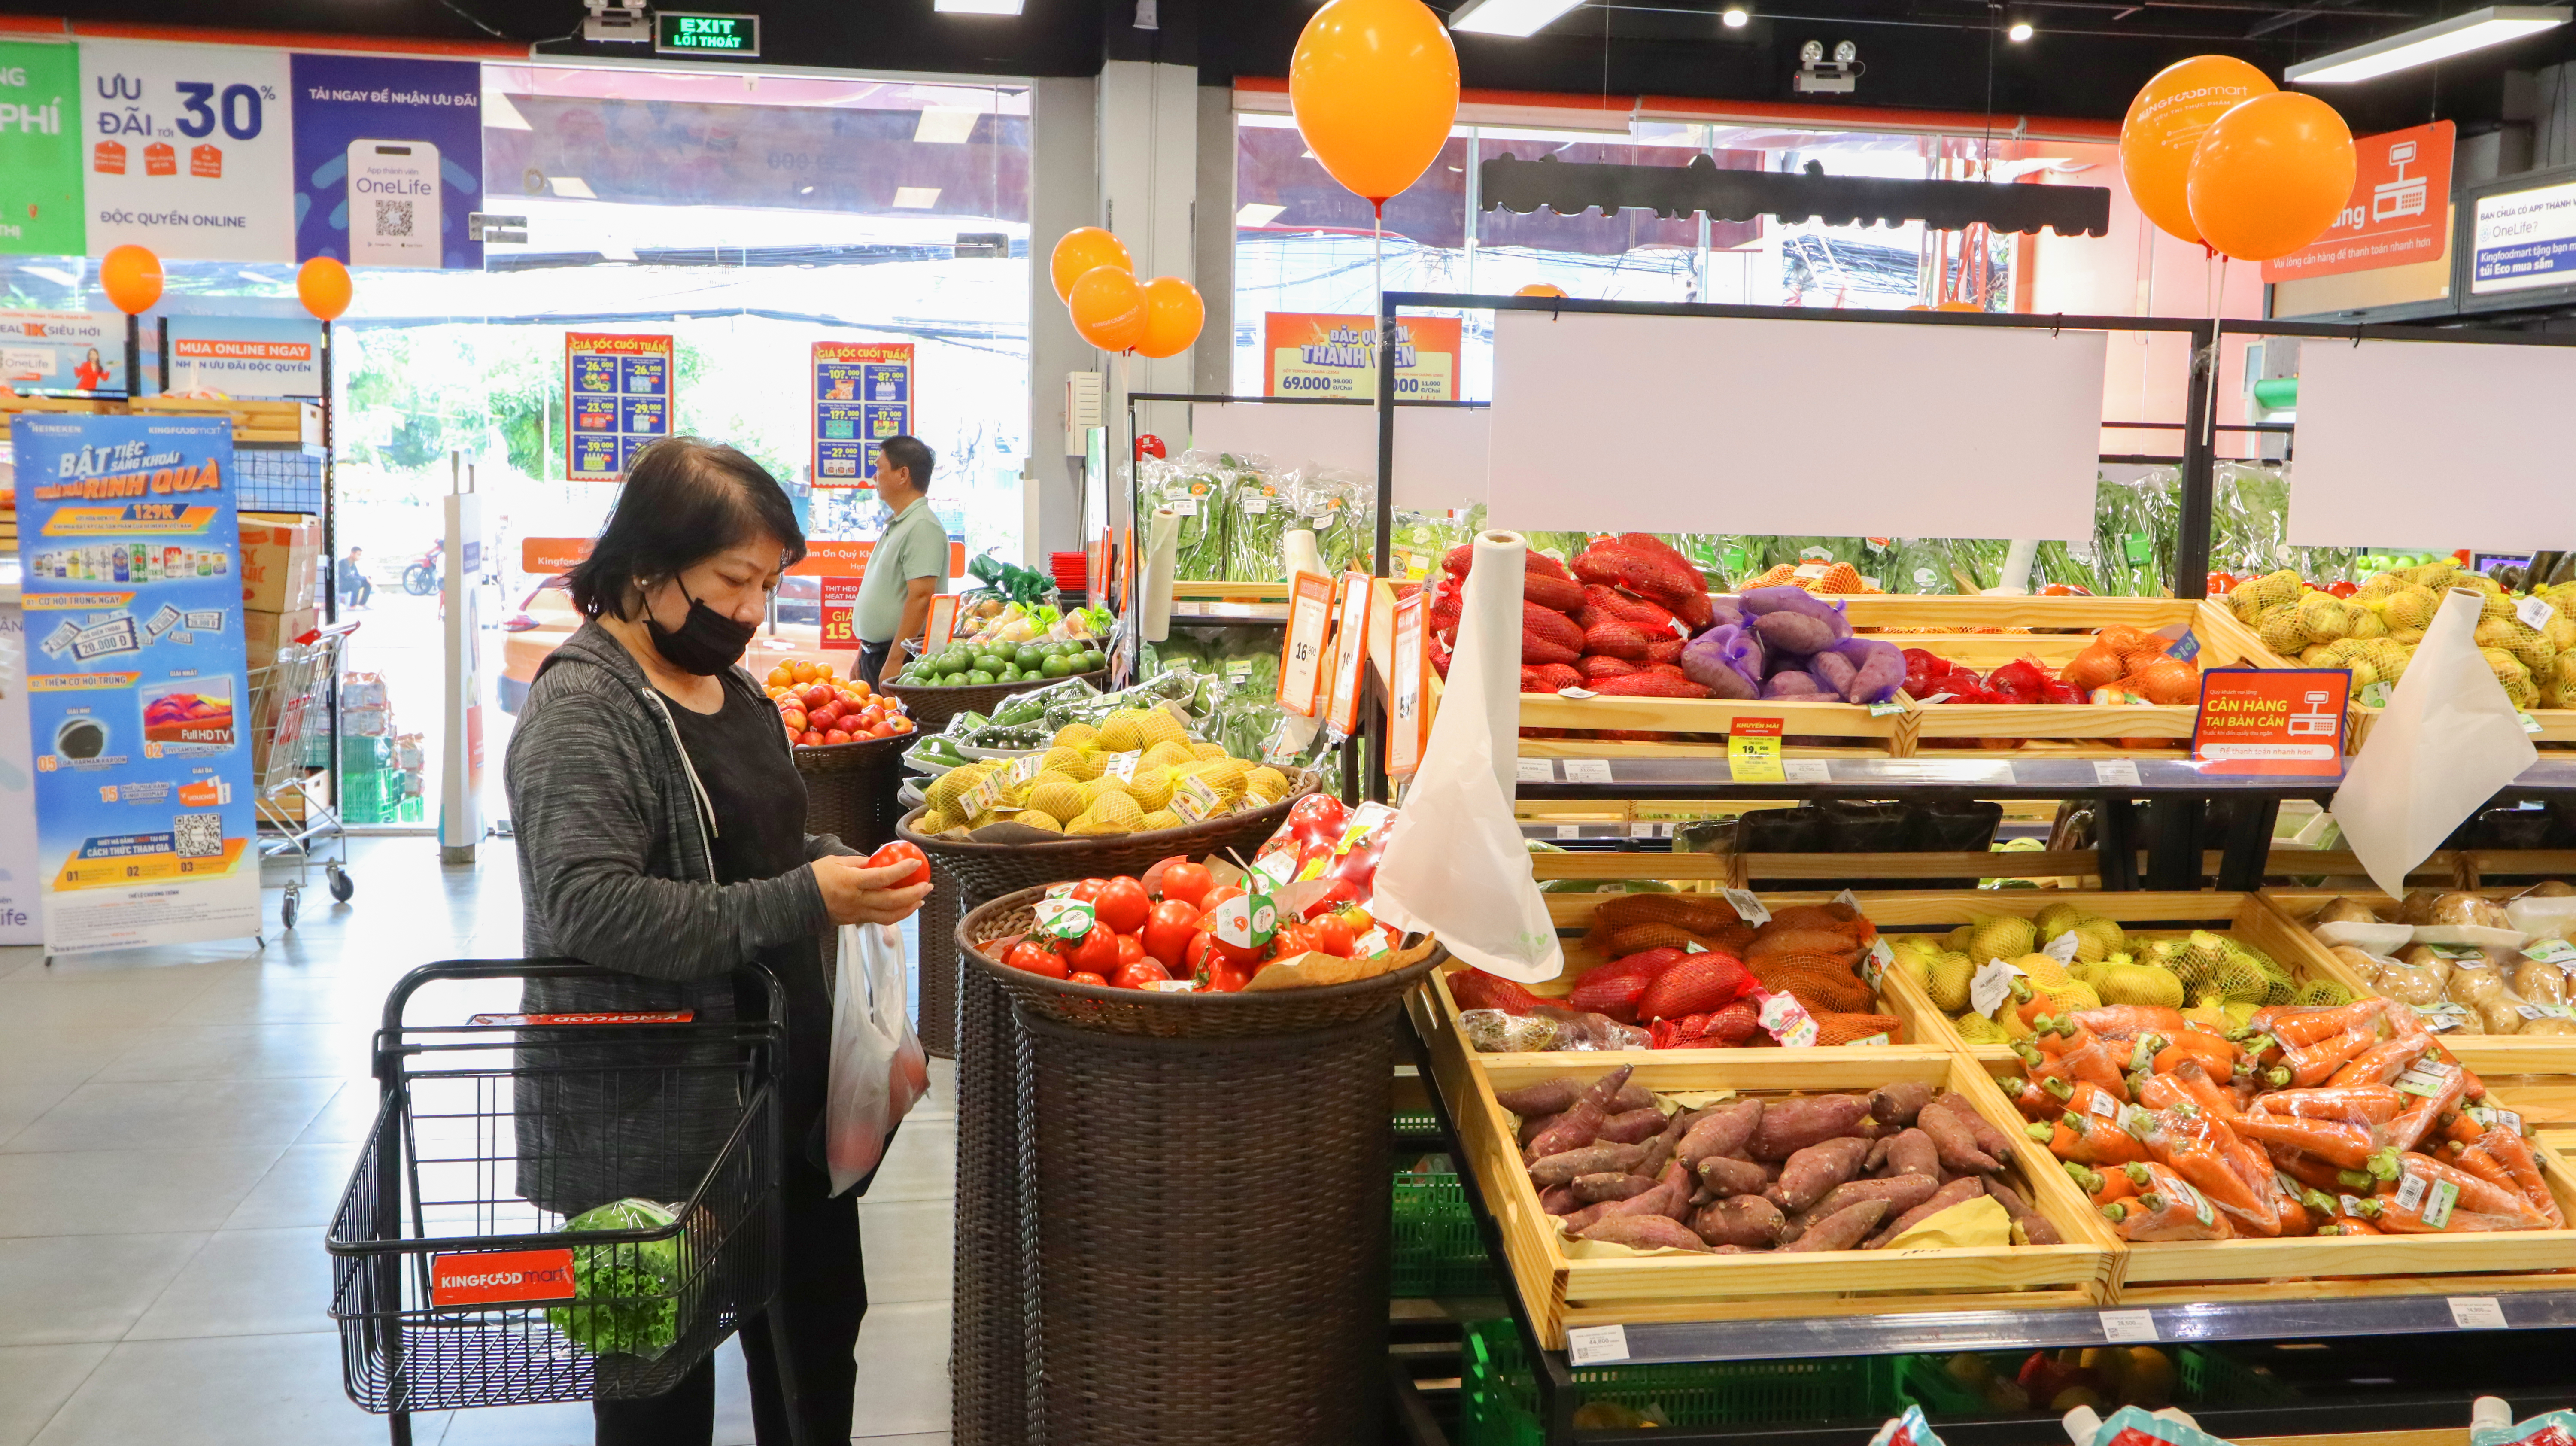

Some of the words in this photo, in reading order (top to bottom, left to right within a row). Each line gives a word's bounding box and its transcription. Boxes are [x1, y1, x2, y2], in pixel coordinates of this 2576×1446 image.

[680, 18, 735, 34] EXIT
[699, 35, 741, 48] THOÁT
[97, 73, 141, 100] ƯU
[309, 86, 329, 100] TẢI
[332, 90, 368, 102] NGAY
[371, 88, 388, 103] ĐỂ
[392, 91, 429, 106] NHẬN
[433, 93, 451, 106] ƯU
[454, 94, 477, 106] ĐÃI
[0, 97, 61, 134] PHÍ
[97, 107, 152, 136] ĐÃI
[367, 167, 381, 176] App
[356, 177, 431, 195] OneLife
[2480, 213, 2494, 222] BẠN
[2529, 204, 2543, 213] APP
[2546, 199, 2571, 210] THÀNH
[100, 211, 133, 224] ĐỘC
[193, 216, 246, 228] ONLINE
[2273, 259, 2285, 269] Vui
[2286, 256, 2302, 268] lòng
[2303, 254, 2315, 265] cân
[2318, 251, 2336, 263] hàng
[2337, 248, 2347, 259] để
[2348, 246, 2369, 258] thanh
[2371, 242, 2388, 255] toán
[2390, 239, 2414, 252] nhanh
[2416, 237, 2431, 248] hơn
[2481, 248, 2532, 263] Kingfoodmart
[2533, 245, 2551, 258] tặng
[2553, 243, 2567, 255] bạn
[2479, 264, 2492, 277] túi
[2494, 263, 2510, 276] Eco
[2512, 261, 2532, 272] mua
[2534, 256, 2554, 270] sắm
[48, 324, 75, 335] SIÊU
[79, 326, 100, 337] HỜI
[1330, 329, 1358, 343] ĐẶC
[179, 343, 211, 354] MUA
[216, 343, 265, 356] ONLINE
[270, 344, 307, 358] NGAY
[573, 339, 592, 350] GIÁ
[593, 337, 612, 349] SỐC
[614, 338, 638, 350] CUỐI
[639, 340, 666, 352] TUẦN
[817, 347, 836, 358] GIÁ
[837, 346, 856, 358] SỐC
[857, 346, 880, 358] CUỐI
[882, 348, 908, 360] TUẦN
[1300, 341, 1366, 368] THÀNH
[6, 358, 49, 369] OneLife
[210, 361, 225, 370] ƯU
[228, 360, 246, 371] ĐÃI
[249, 360, 271, 373] ĐỘC
[275, 360, 311, 373] QUYỀN
[1283, 376, 1331, 391] 69.000
[115, 440, 146, 457] TIỆC
[59, 444, 112, 480] BẬT
[141, 451, 180, 468] KHOÁI
[84, 474, 149, 499] RINH
[150, 457, 220, 494] QUÀ
[133, 504, 175, 519] 129K
[823, 548, 836, 558] Ơn
[838, 549, 857, 559] Quý
[1390, 542, 1416, 552] ORGANIC
[1417, 548, 1435, 556] HAPPY
[39, 597, 50, 606] CƠ
[53, 595, 67, 606] HỘI
[70, 594, 96, 605] TRÚNG
[99, 595, 120, 605] NGAY
[82, 637, 117, 654] 20.000
[120, 635, 127, 646] Đ
[44, 676, 67, 687] THÊM
[83, 675, 96, 687] HỘI
[98, 674, 126, 684] TRÚNG
[2207, 696, 2239, 712] CÂN
[2243, 697, 2288, 712] HÀNG
[2206, 717, 2225, 729] TẠI
[2228, 715, 2255, 727] BÀN
[2258, 714, 2285, 727] CÂN
[182, 730, 197, 740] Full
[198, 730, 214, 740] HD
[214, 730, 229, 741] TV
[145, 743, 163, 759] 02
[2220, 747, 2230, 755] Để
[38, 755, 58, 772] 05
[99, 785, 118, 802] 15
[152, 781, 169, 789] HÀNG
[122, 790, 168, 799] KINGFOODMART
[86, 846, 109, 857] CÁCH
[109, 845, 131, 856] THỨC
[133, 844, 155, 854] THAM
[155, 843, 170, 852] GIA
[127, 866, 140, 877] 02
[181, 862, 194, 872] 03
[67, 871, 79, 881] 01
[441, 1266, 565, 1288] KINGFOODmart
